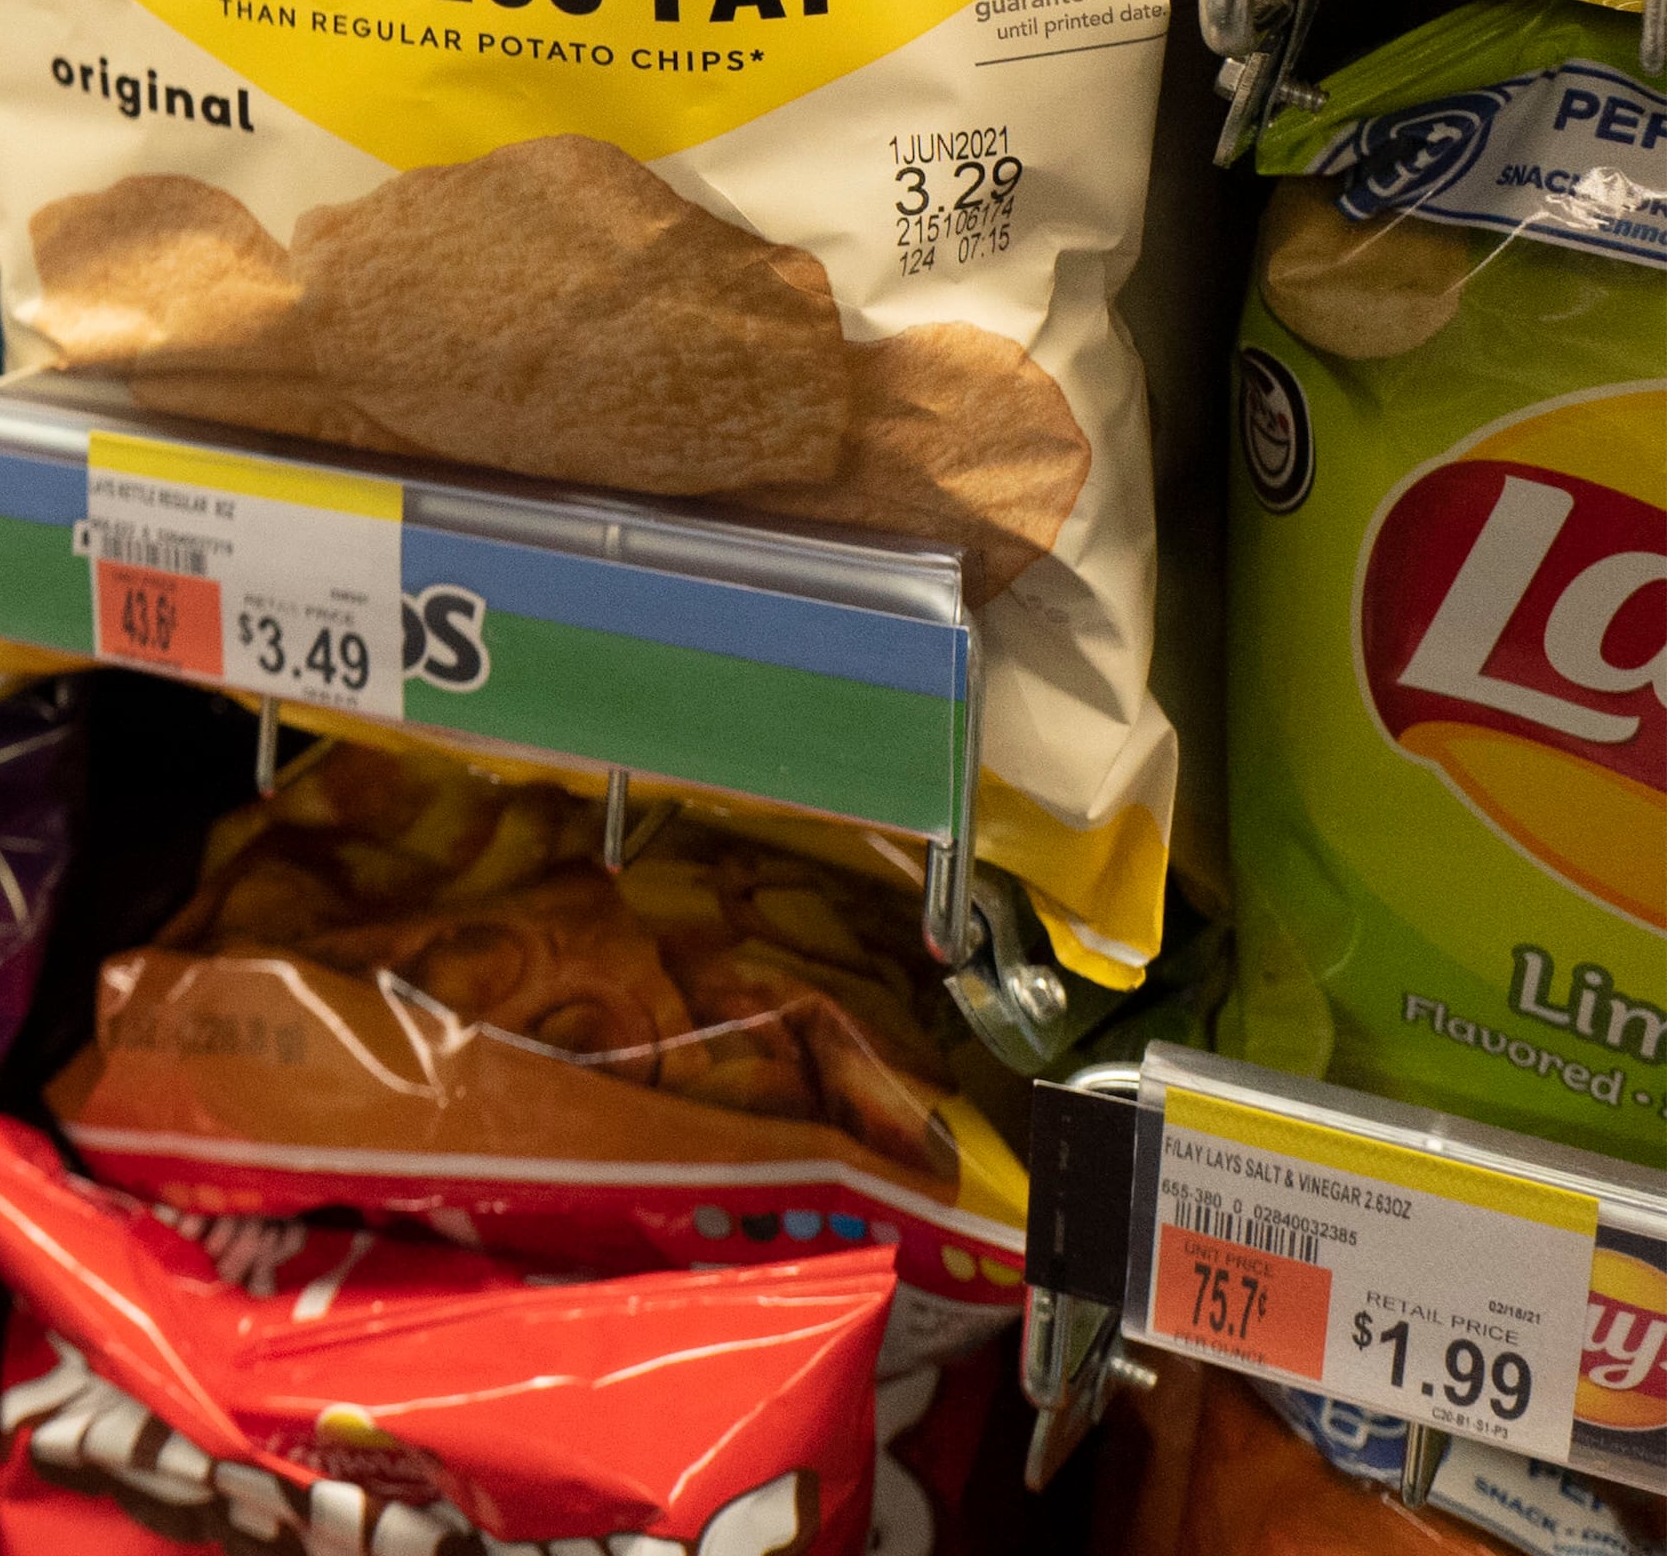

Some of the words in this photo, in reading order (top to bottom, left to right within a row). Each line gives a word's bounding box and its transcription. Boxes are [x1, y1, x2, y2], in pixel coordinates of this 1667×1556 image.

[311, 7, 463, 54] REGULAR
[477, 31, 617, 68] POTATO
[996, 18, 1039, 41] until
[1043, 10, 1114, 39] printed
[50, 53, 256, 134] original
[888, 125, 1010, 166] 1JUN2021
[894, 155, 1024, 217] 3.29
[898, 246, 937, 278] 124
[957, 224, 1011, 265] 07:15
[237, 610, 371, 692] $3.49
[1402, 992, 1625, 1109] Flavored
[1205, 1148, 1243, 1175] LAYS
[1244, 1157, 1282, 1185] SALT
[1283, 1169, 1295, 1188] &
[1299, 1171, 1361, 1208] VINEGAR
[1161, 1178, 1223, 1209] 655-380
[1233, 1198, 1243, 1215] 0
[1253, 1204, 1358, 1247] 02840032385
[1366, 1290, 1445, 1327] RETAIL
[1449, 1313, 1521, 1347] PRICE
[1352, 1309, 1534, 1422] $1.99
